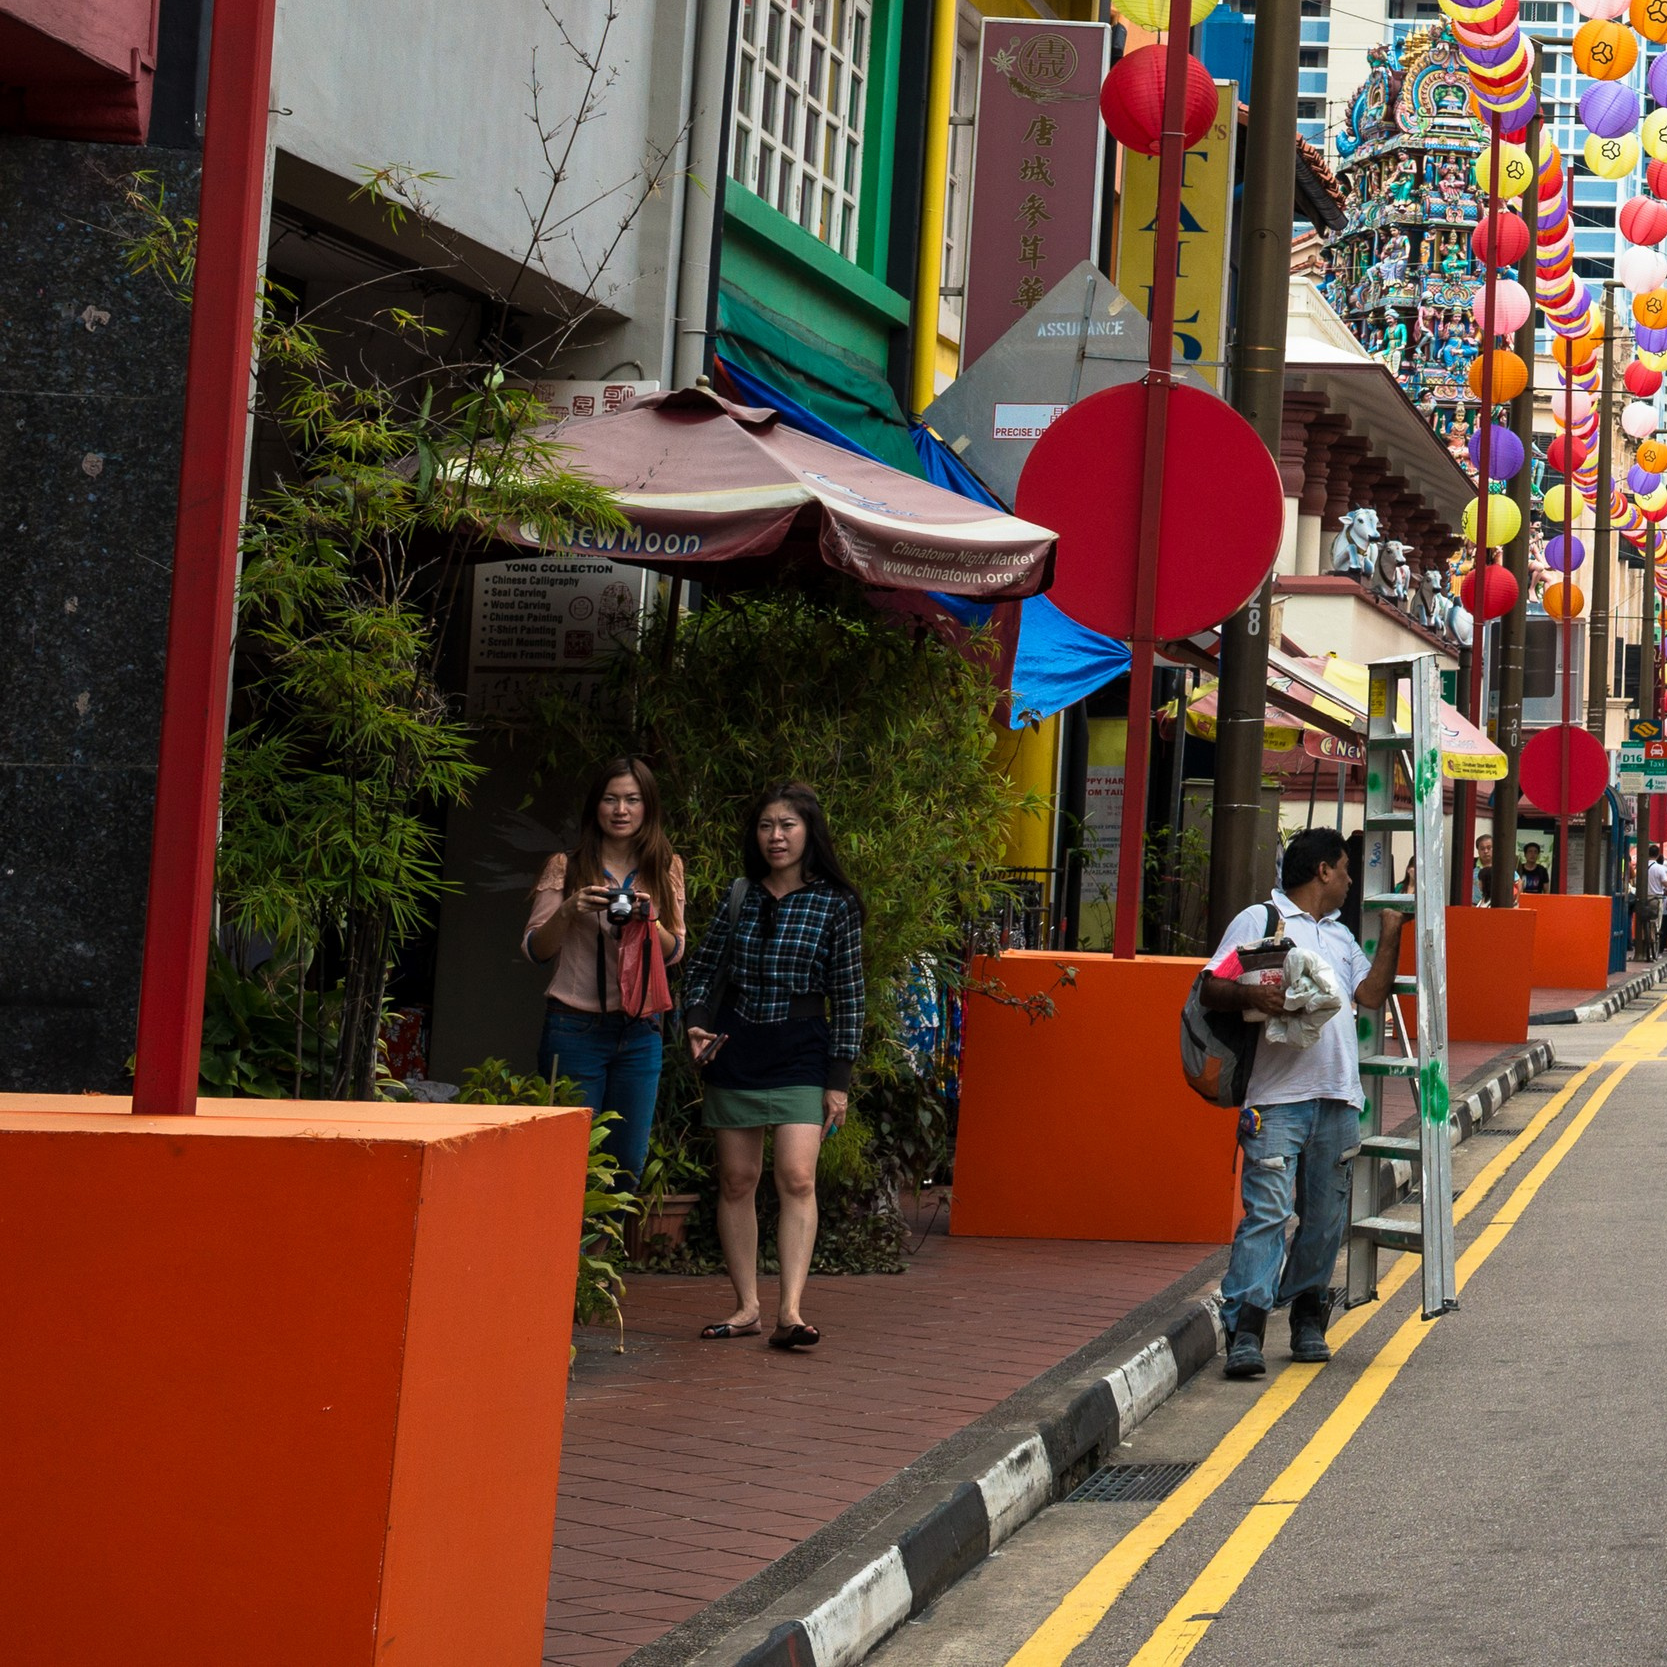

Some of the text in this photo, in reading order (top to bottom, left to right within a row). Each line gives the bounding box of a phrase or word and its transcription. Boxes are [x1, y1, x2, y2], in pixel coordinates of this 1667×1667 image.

[1037, 320, 1125, 338] ASSUANCE
[995, 427, 1033, 437] PRECISE
[892, 541, 954, 562] Chinatown
[957, 550, 988, 567] Night
[989, 552, 1036, 566] Market
[505, 563, 613, 574] YONG COLLECTION
[492, 575, 580, 588] Chinese Calligraphy
[491, 588, 547, 599] Seal Carving
[490, 600, 551, 612] Wood Carving
[489, 612, 563, 624] Chinese Painting
[489, 625, 557, 636] T-Shirt Painting
[487, 637, 557, 649] Scroll Mounting
[486, 650, 557, 661] Picture Framing
[1622, 754, 1642, 762] D16
[1645, 778, 1654, 789] 4
